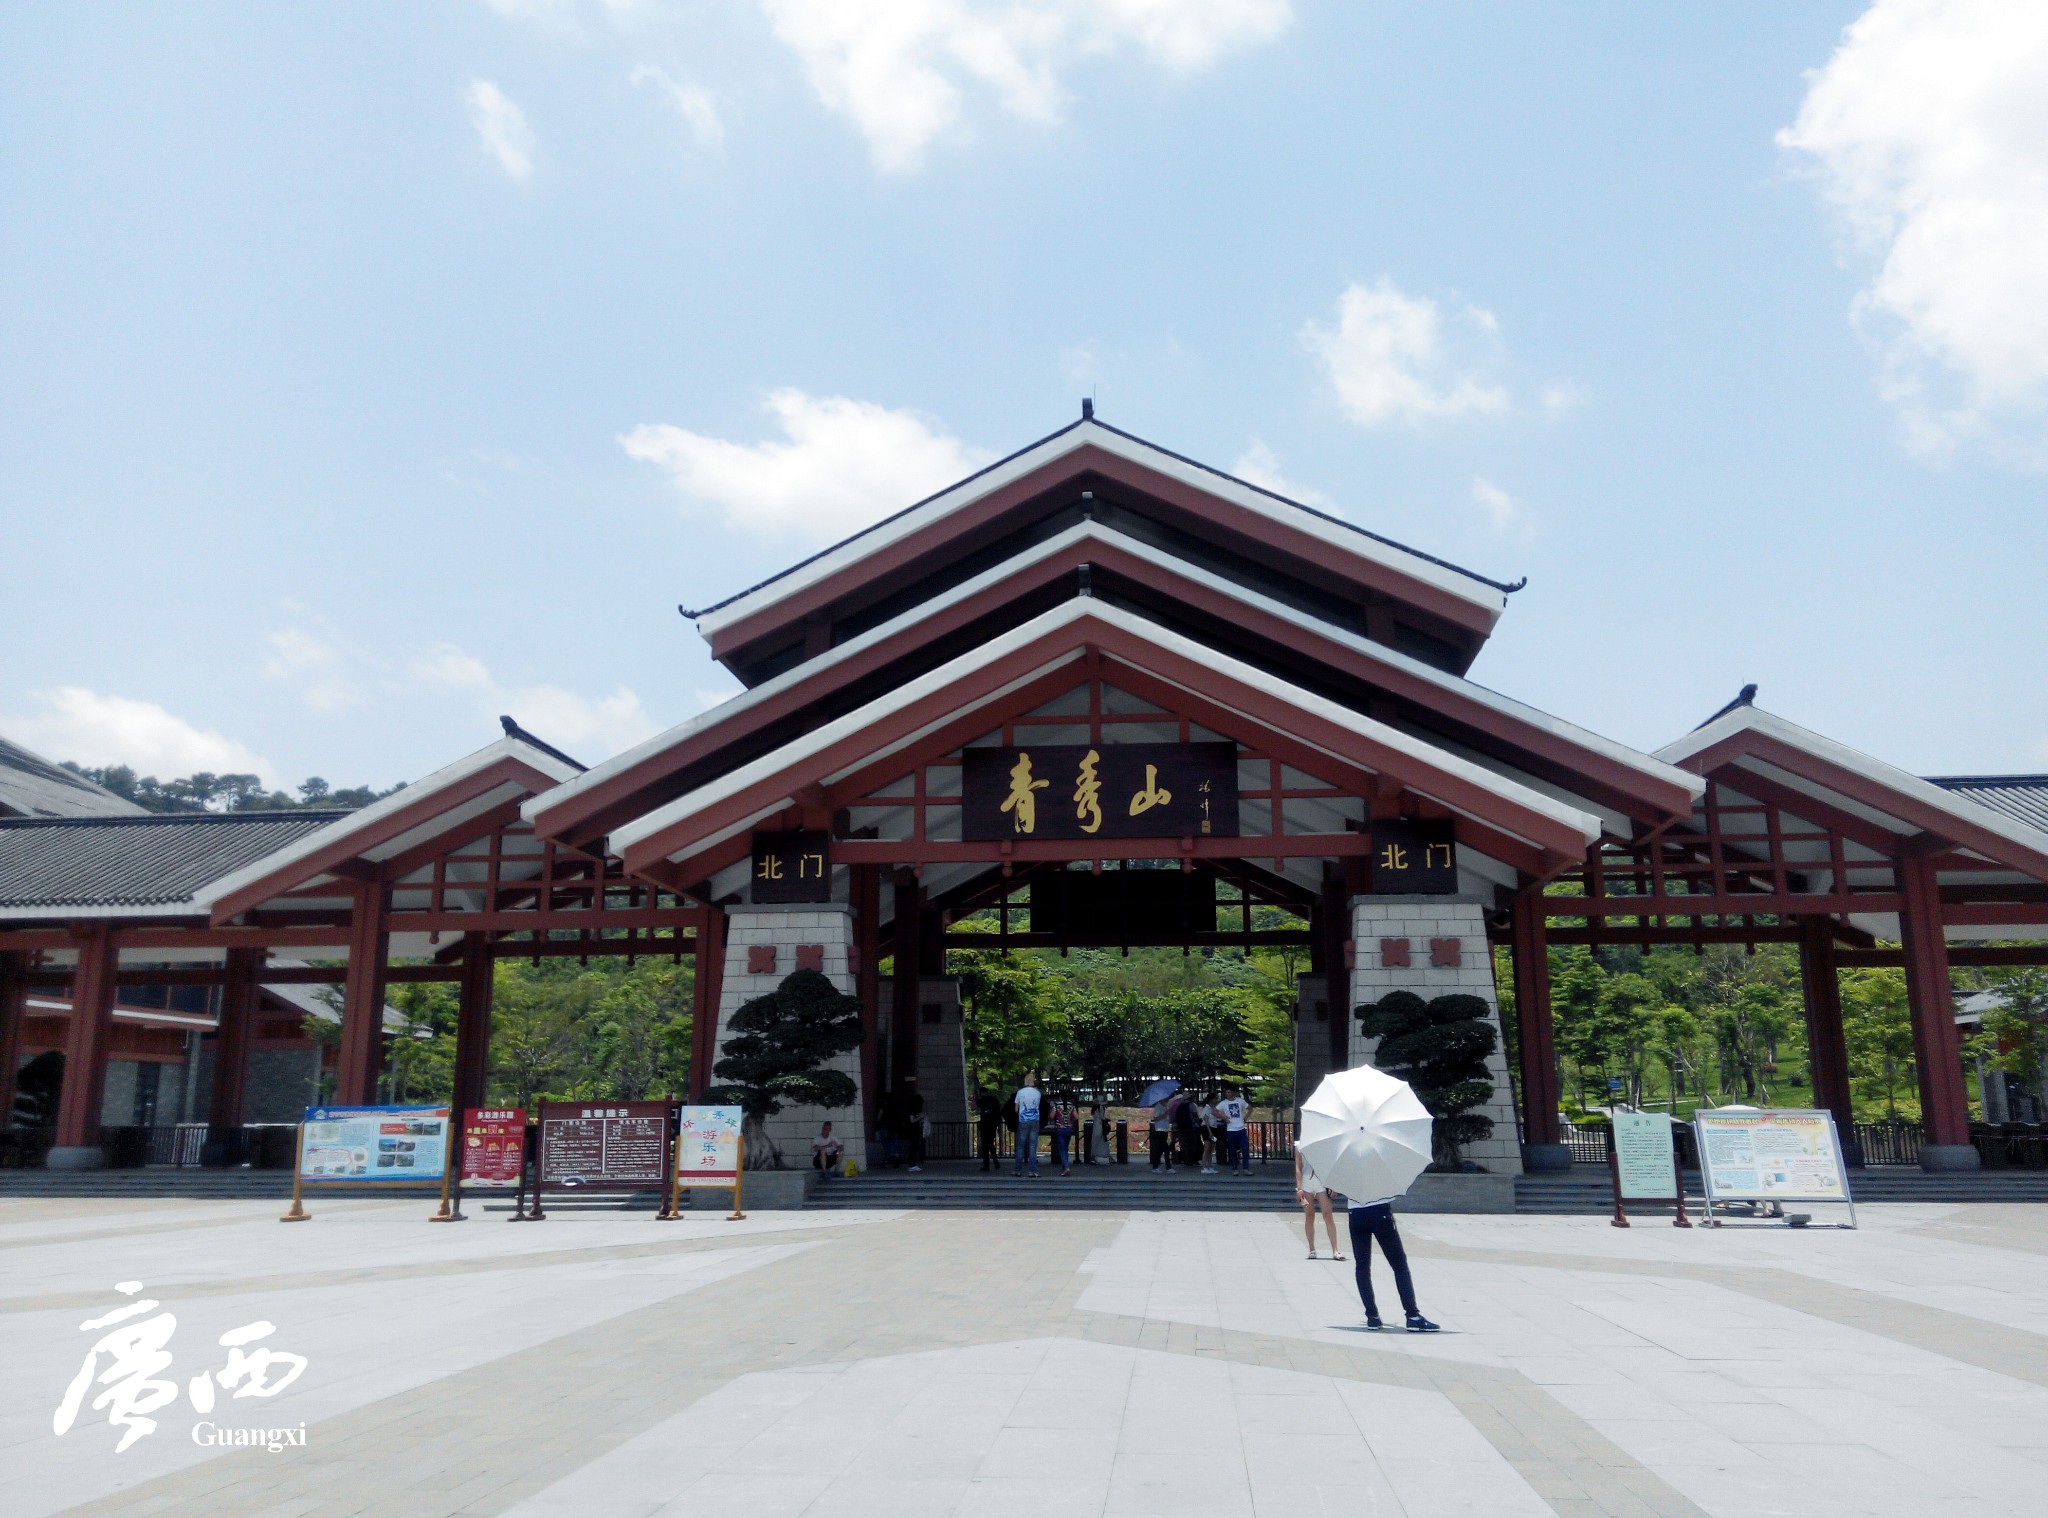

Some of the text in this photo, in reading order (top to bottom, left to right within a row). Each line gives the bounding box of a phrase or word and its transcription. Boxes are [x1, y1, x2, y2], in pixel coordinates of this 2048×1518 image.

[1000, 749, 1172, 833] 青秀山
[757, 854, 823, 880] 北门
[1380, 843, 1452, 870] 北门
[700, 1130, 718, 1167] 游乐场
